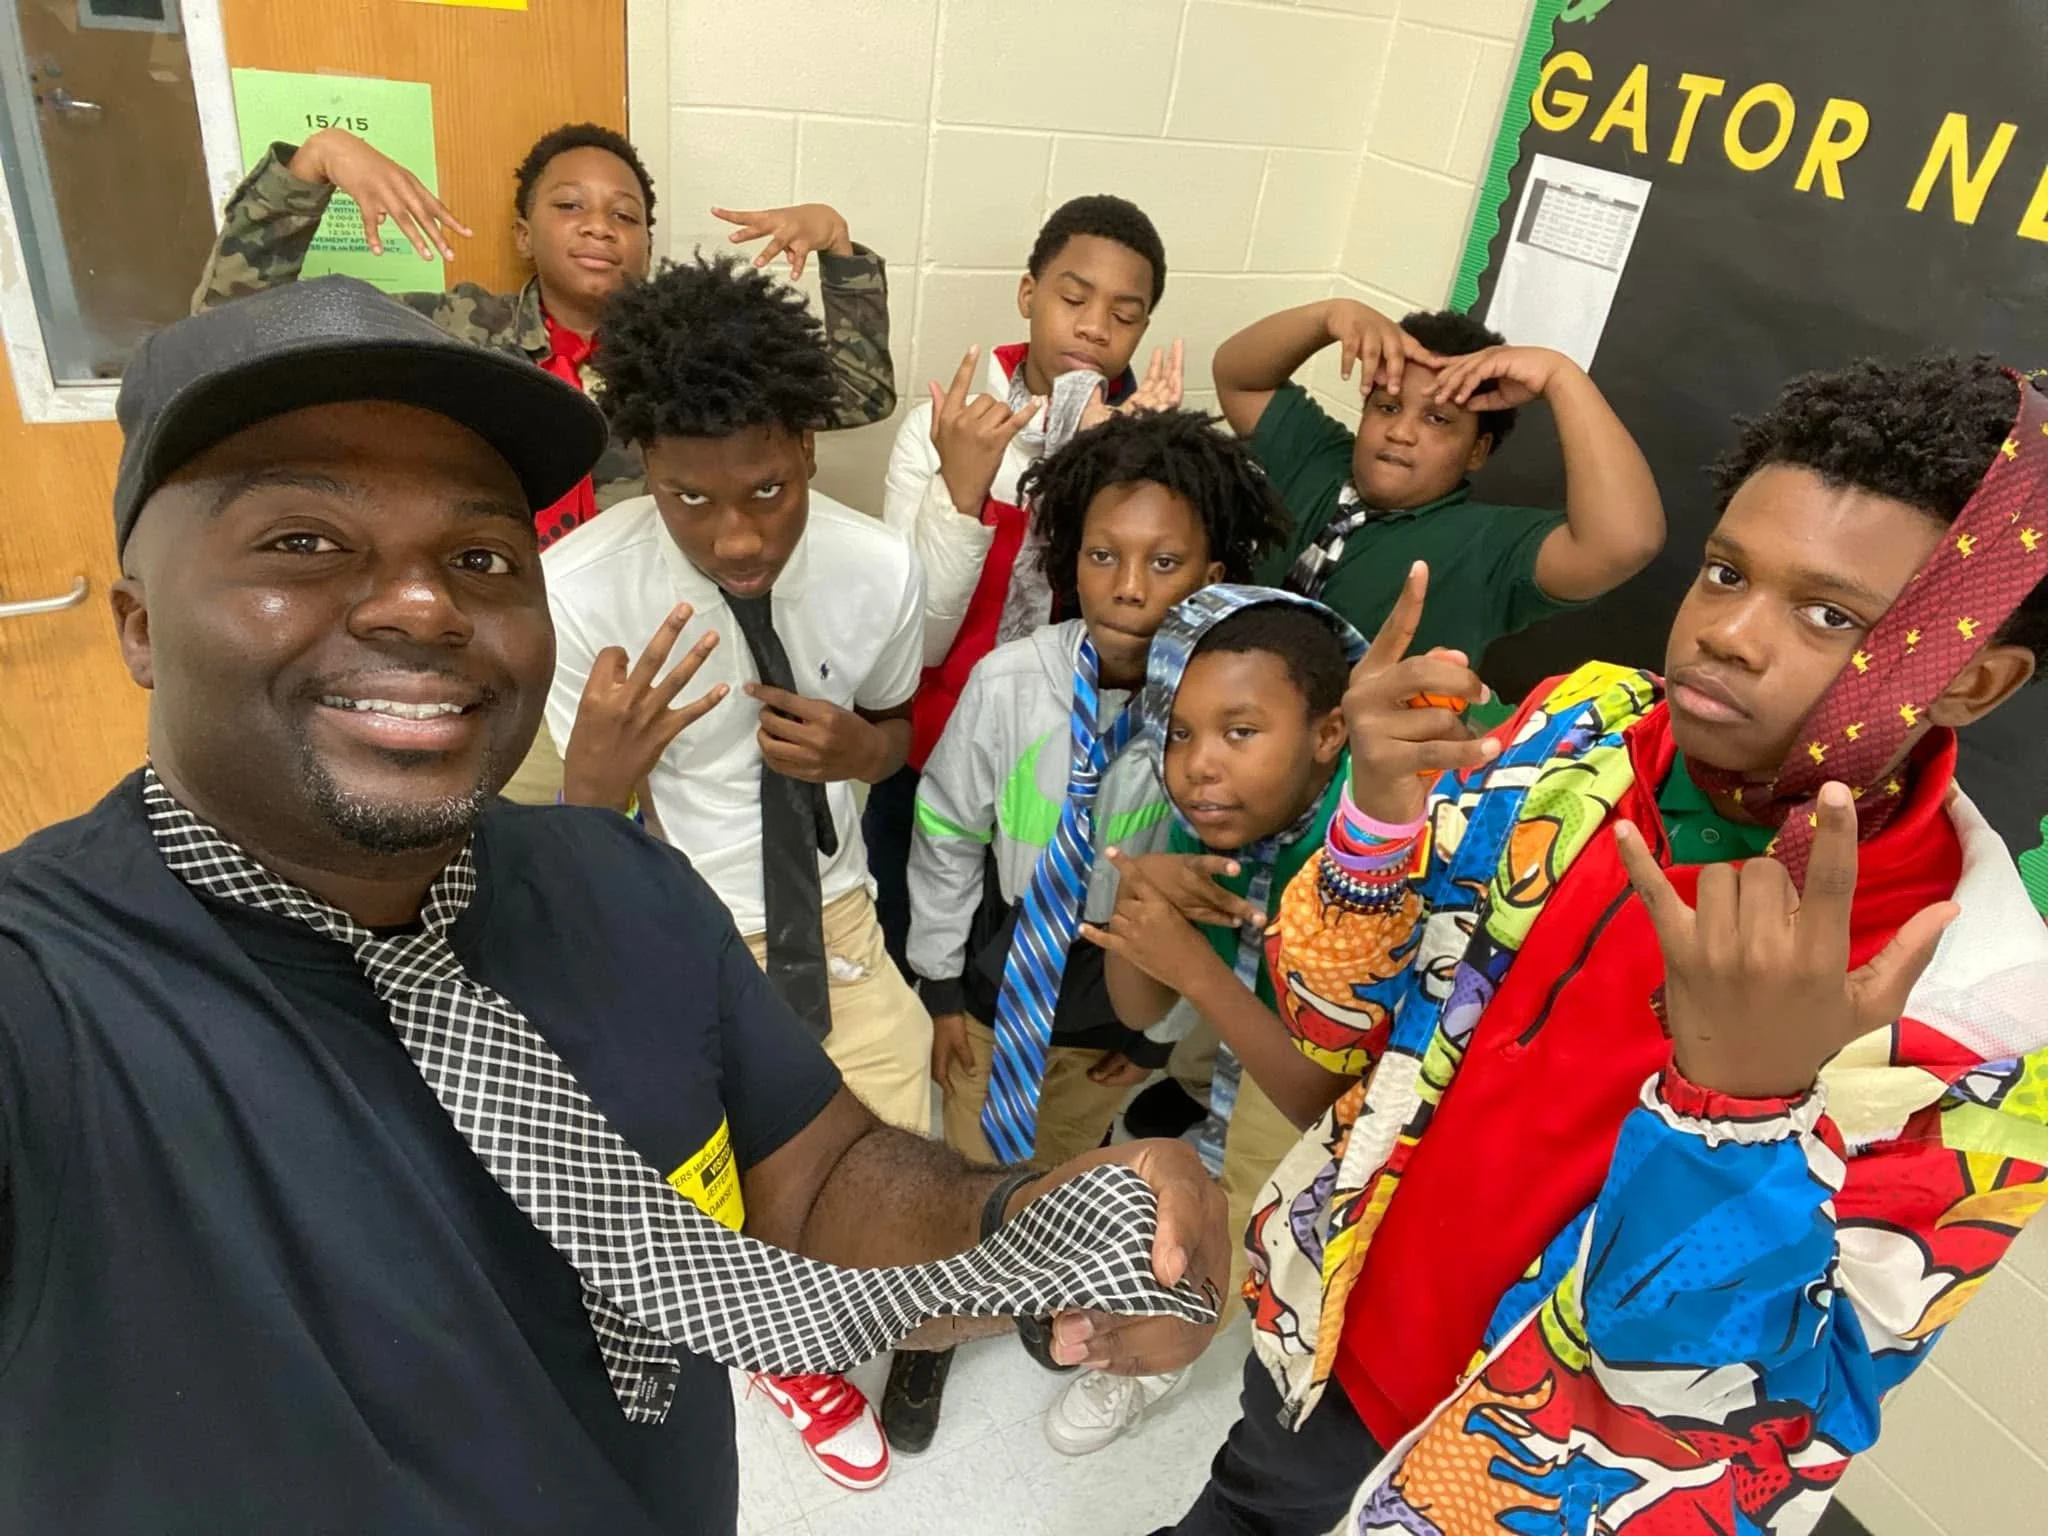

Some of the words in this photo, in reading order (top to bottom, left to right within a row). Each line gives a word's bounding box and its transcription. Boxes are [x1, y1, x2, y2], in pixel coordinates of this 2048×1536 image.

[305, 113, 369, 132] 15/15
[1532, 51, 1870, 200] GATOR
[673, 1170, 692, 1189] ERS
